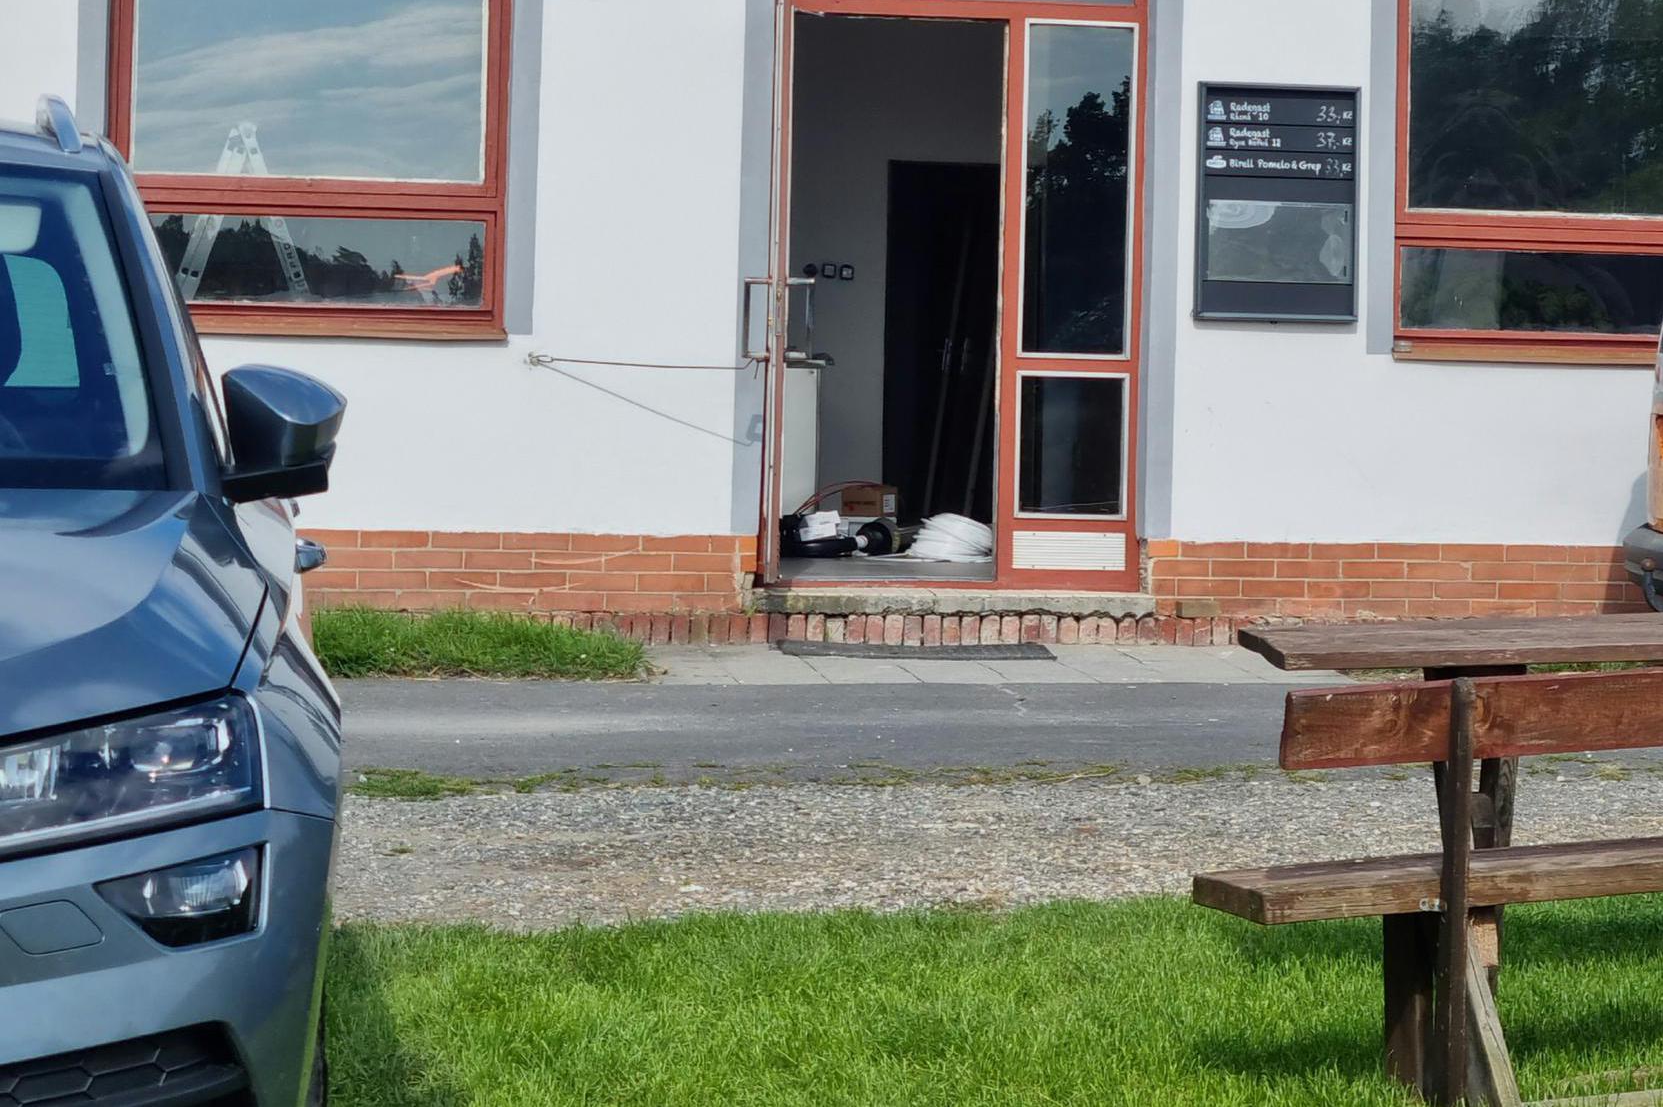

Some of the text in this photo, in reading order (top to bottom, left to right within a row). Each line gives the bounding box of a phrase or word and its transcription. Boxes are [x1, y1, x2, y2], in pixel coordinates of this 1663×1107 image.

[1229, 101, 1271, 115] Radegast
[1258, 112, 1269, 121] 10
[1229, 127, 1271, 140] Radegast
[1229, 159, 1254, 169] Birell
[1258, 159, 1290, 170] Pomelo
[1291, 160, 1298, 170] &
[1298, 161, 1322, 176] Grep
